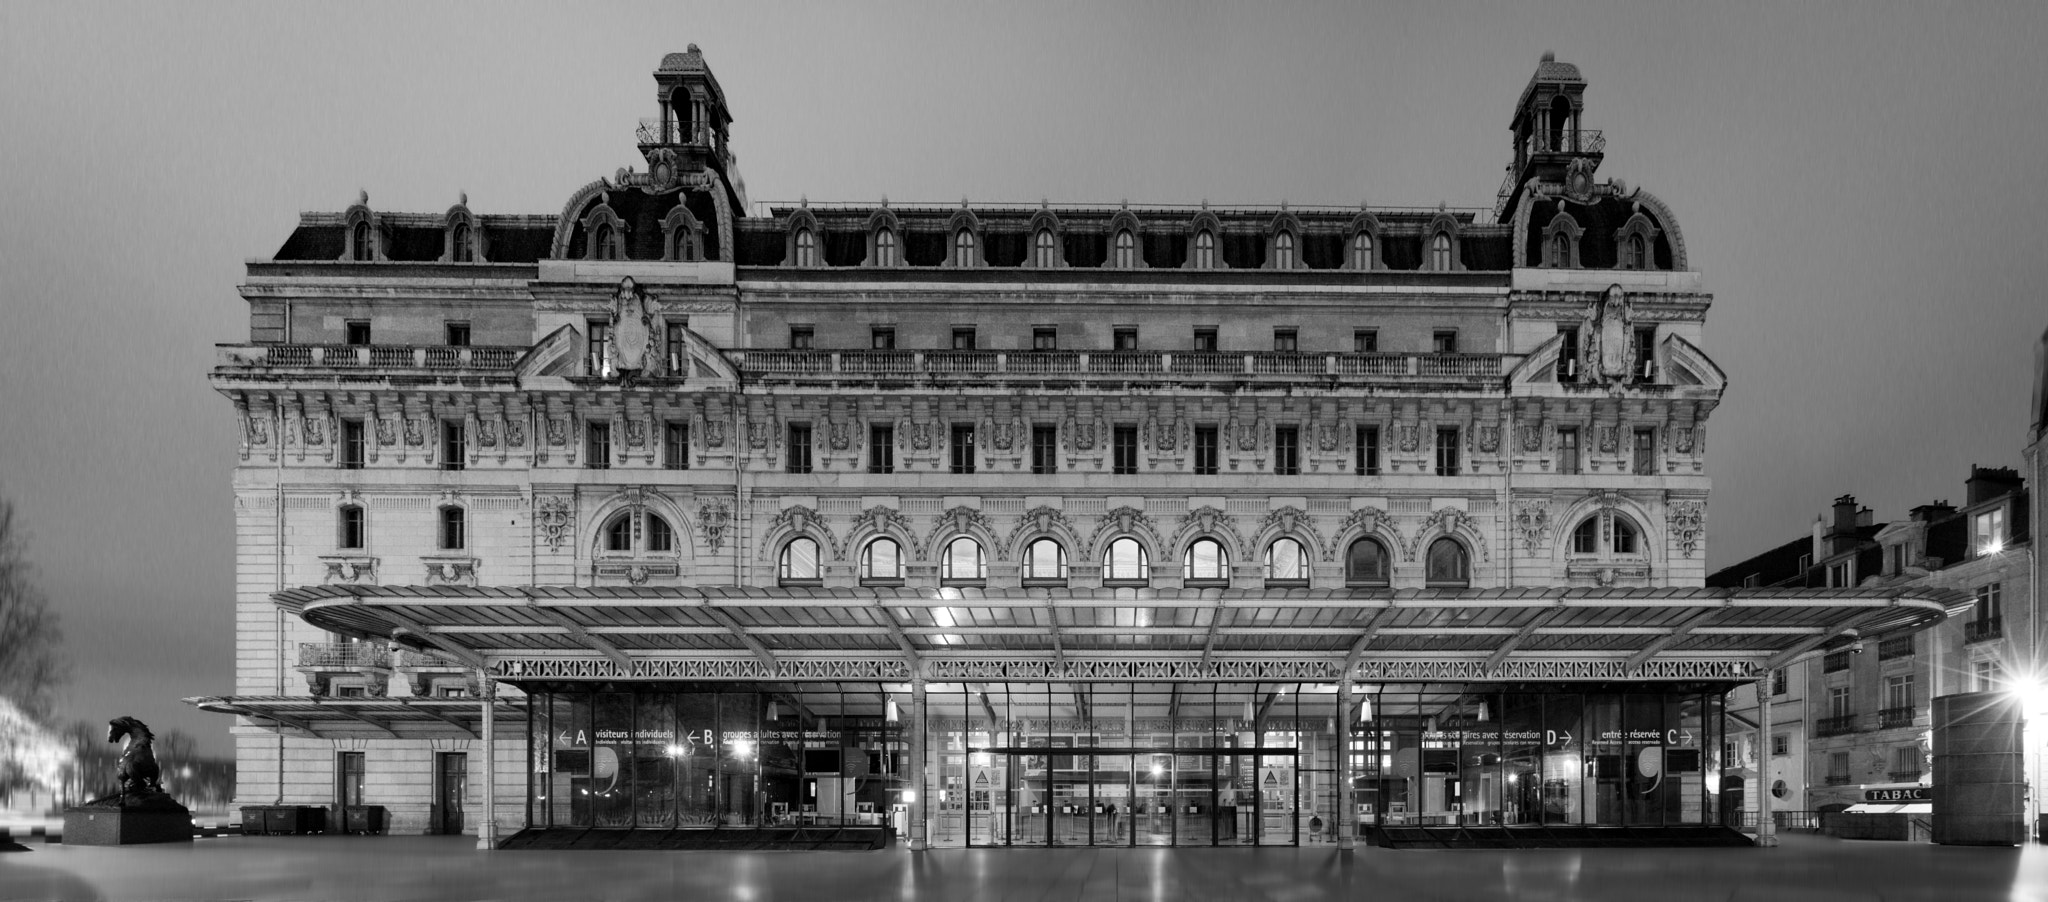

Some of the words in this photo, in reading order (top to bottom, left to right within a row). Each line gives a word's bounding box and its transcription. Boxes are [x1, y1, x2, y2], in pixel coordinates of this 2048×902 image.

[576, 729, 587, 744] A
[595, 729, 628, 738] visiteurs
[631, 729, 674, 738] individuels
[704, 729, 713, 744] B
[723, 731, 751, 740] groupes
[1448, 731, 1480, 739] scoaires
[1547, 729, 1556, 745] D
[1602, 730, 1627, 738] entrée
[1630, 729, 1660, 738] réservée
[1667, 729, 1677, 744] C
[1872, 789, 1922, 800] TABAC
